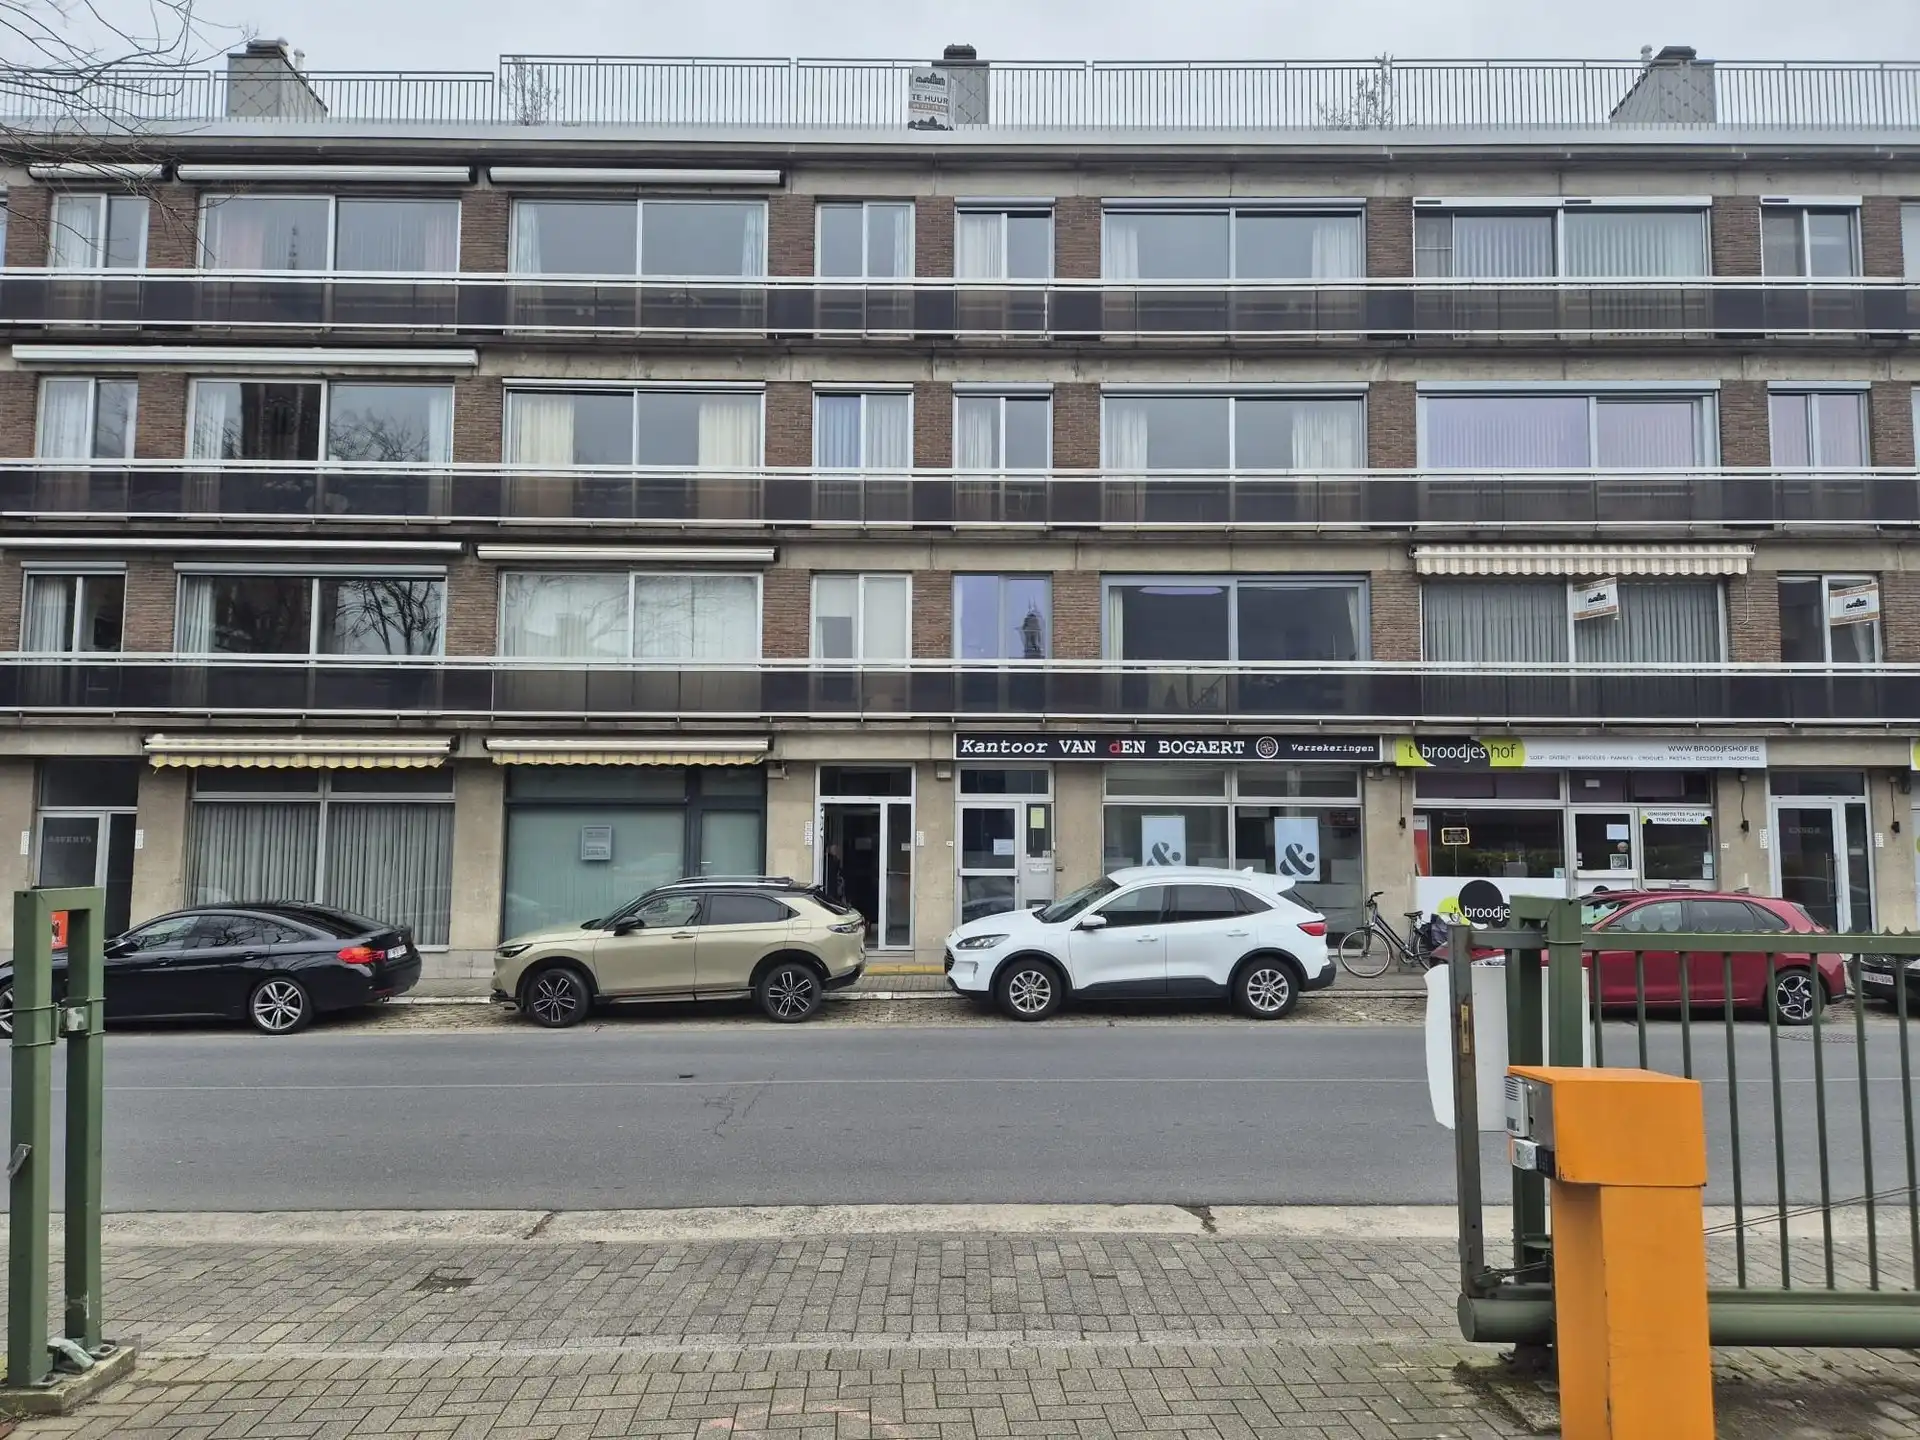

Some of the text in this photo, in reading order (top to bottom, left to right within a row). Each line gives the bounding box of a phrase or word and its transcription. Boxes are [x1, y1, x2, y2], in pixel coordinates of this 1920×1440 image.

[912, 93, 949, 105] TE HUUR
[960, 739, 1245, 754] Kantoor VAN dEN BOGAERT
[1291, 744, 1374, 754] Verzekeringen
[1405, 743, 1516, 763] 't broodjes hof
[1667, 745, 1760, 753] WWW.BROODJESHOF.BE
[1464, 906, 1511, 921] broodje
